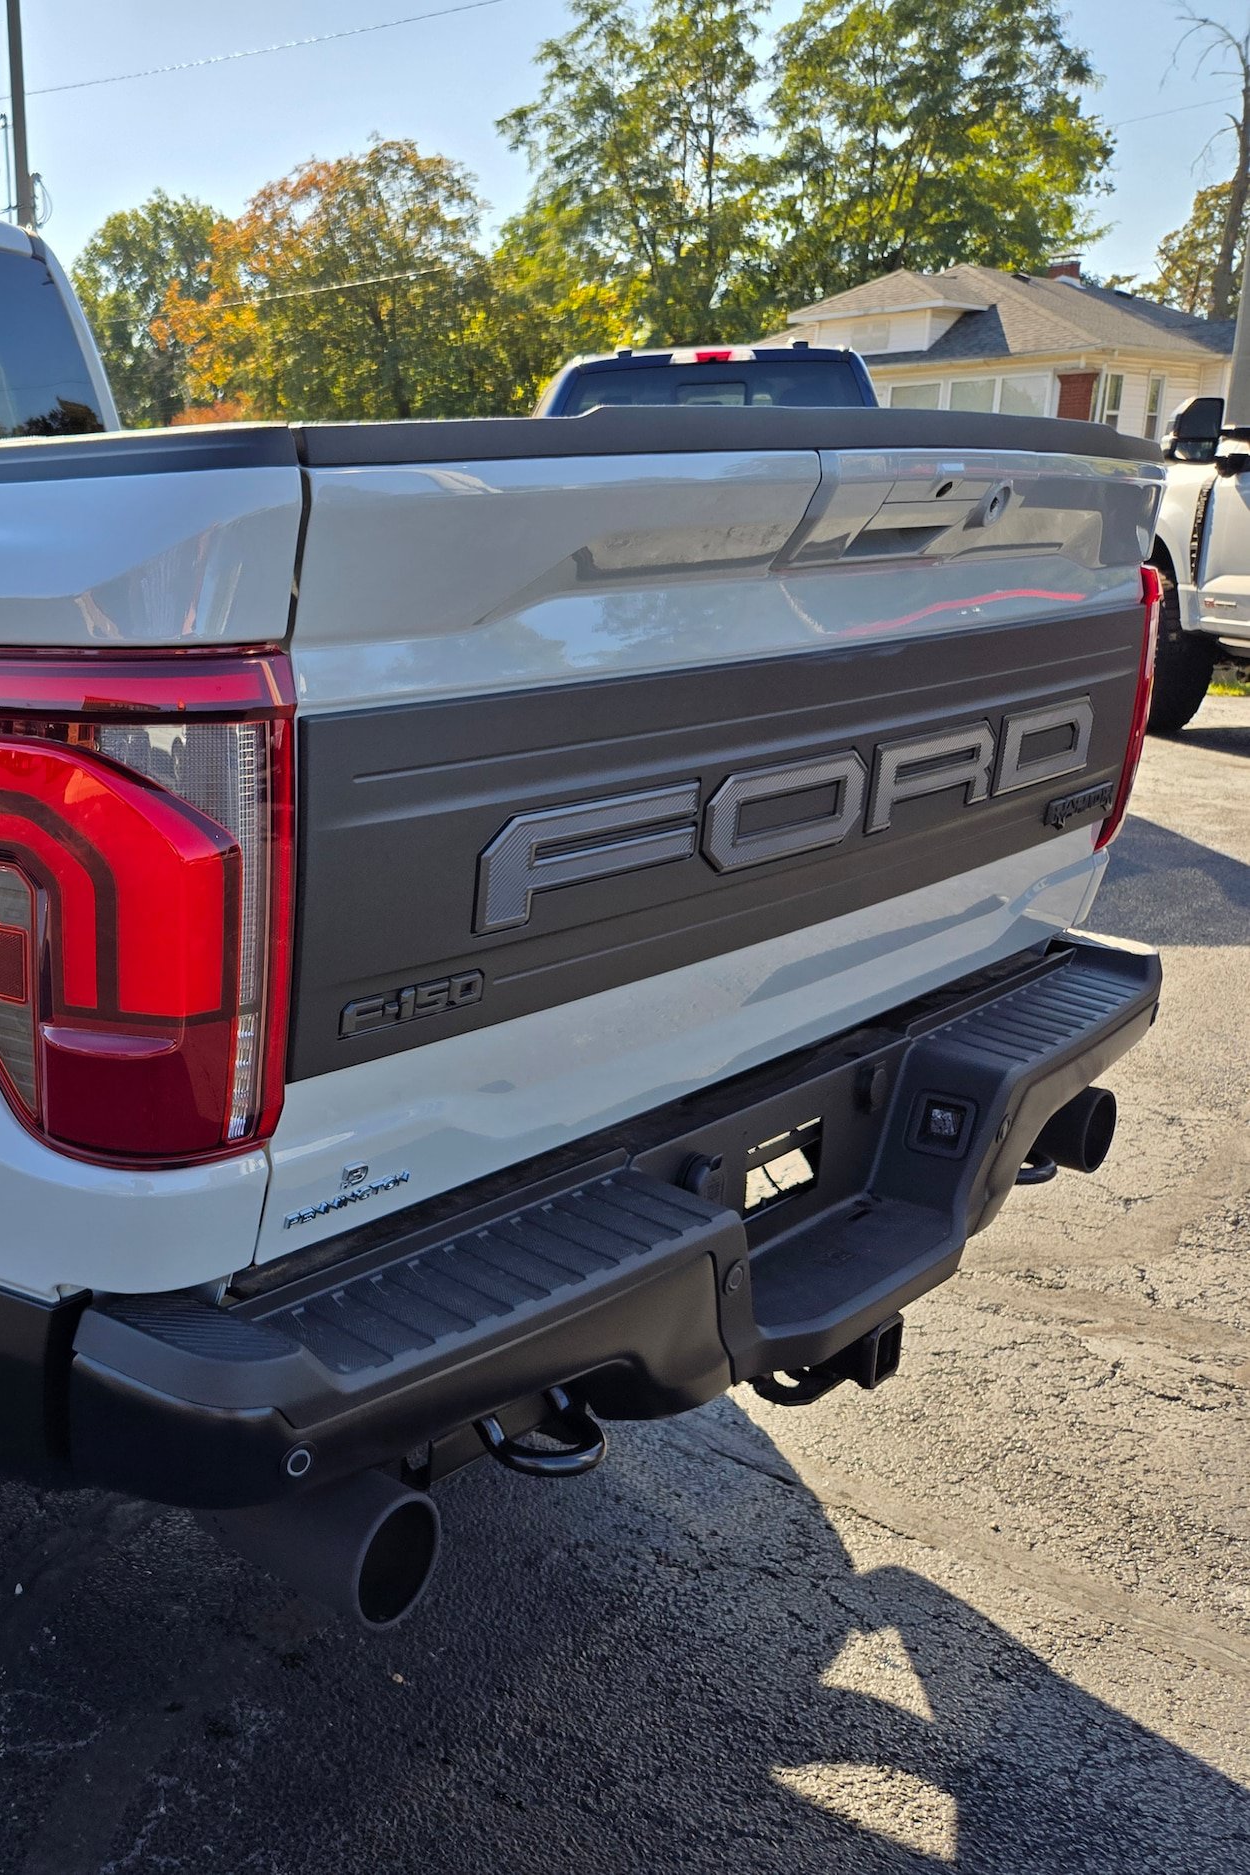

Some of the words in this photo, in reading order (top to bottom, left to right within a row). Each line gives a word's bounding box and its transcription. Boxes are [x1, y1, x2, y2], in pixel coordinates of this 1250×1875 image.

[472, 695, 1094, 934] FORD
[338, 968, 485, 1039] F-150
[283, 1170, 410, 1229] PENNINGTON
